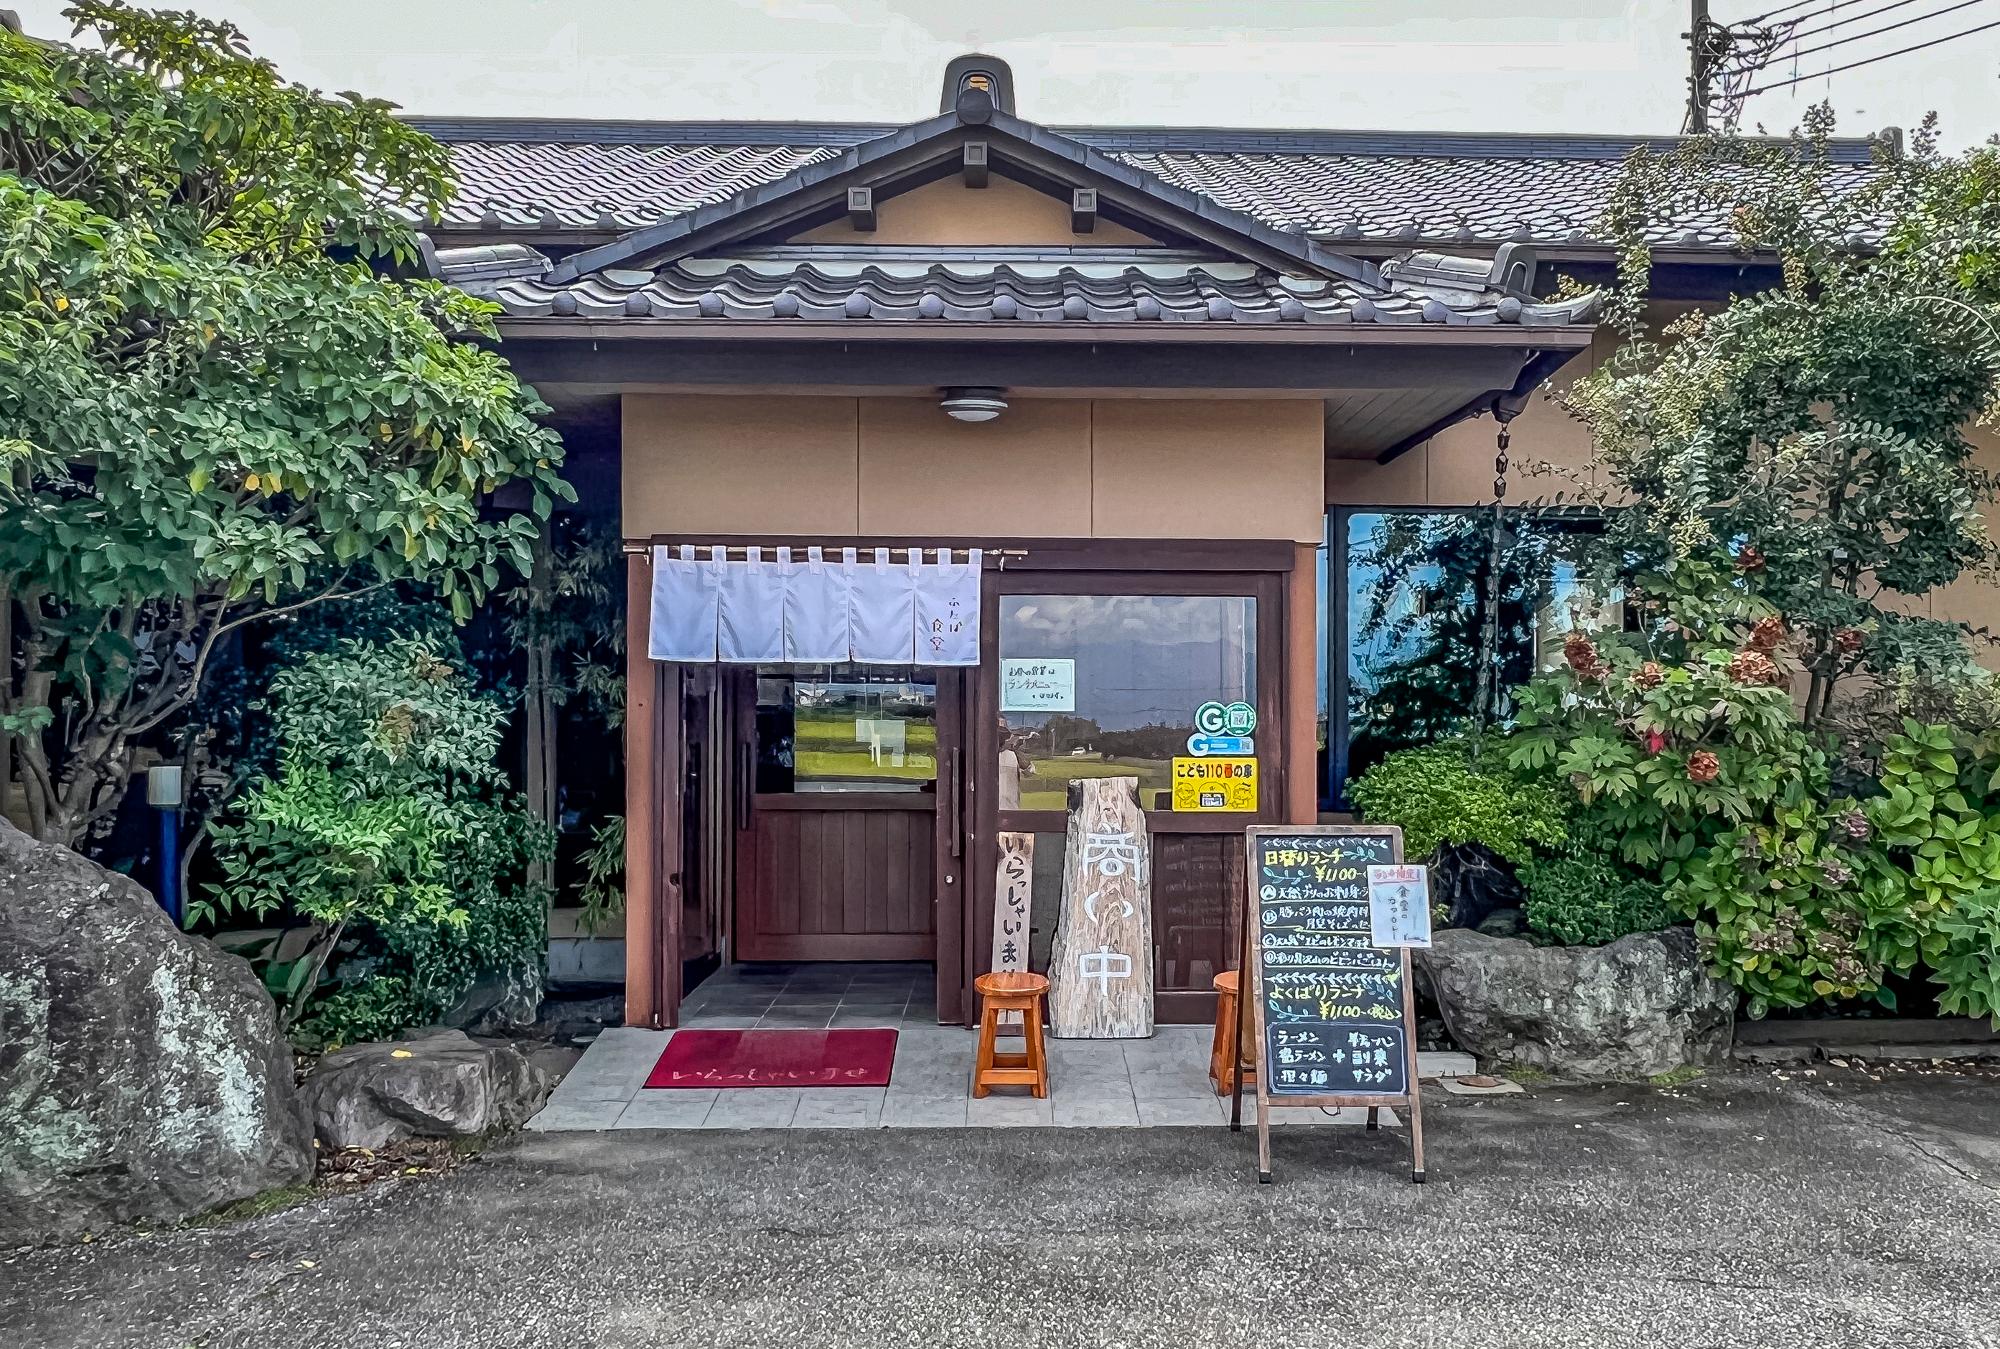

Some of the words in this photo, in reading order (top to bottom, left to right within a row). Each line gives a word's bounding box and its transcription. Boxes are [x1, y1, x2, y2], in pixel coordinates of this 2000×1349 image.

[929, 618, 945, 651] 食堂
[1001, 836, 1027, 977] いらっしゃいま
[1278, 1030, 1319, 1044] ラーメン
[1352, 1068, 1392, 1082] サラダ
